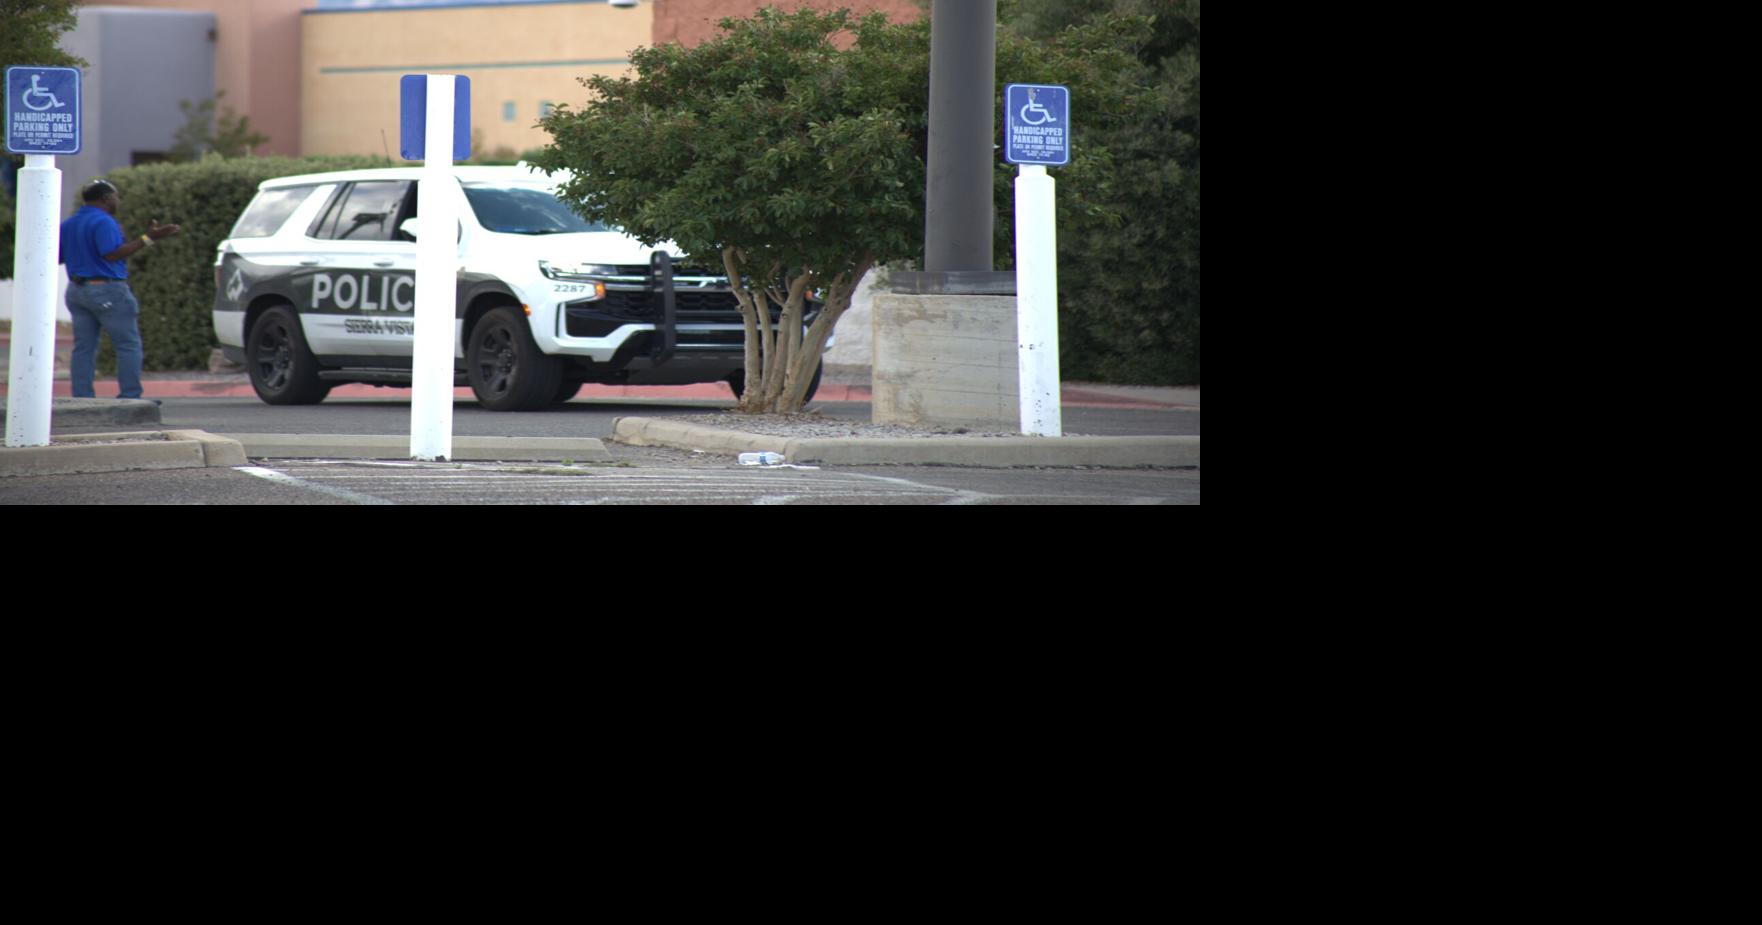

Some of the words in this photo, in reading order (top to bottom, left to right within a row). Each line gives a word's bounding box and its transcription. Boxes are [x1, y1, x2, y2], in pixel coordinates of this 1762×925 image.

[14, 112, 72, 122] HANDICAPPED
[13, 122, 49, 131] PARKING
[52, 123, 72, 132] ONLY
[1013, 126, 1062, 136] HANDICAPPED
[1012, 135, 1043, 144] PARKING
[1045, 136, 1062, 145] ONLY
[312, 274, 414, 311] POLIC
[554, 284, 586, 293] 2287
[344, 319, 384, 334] SIERRA
